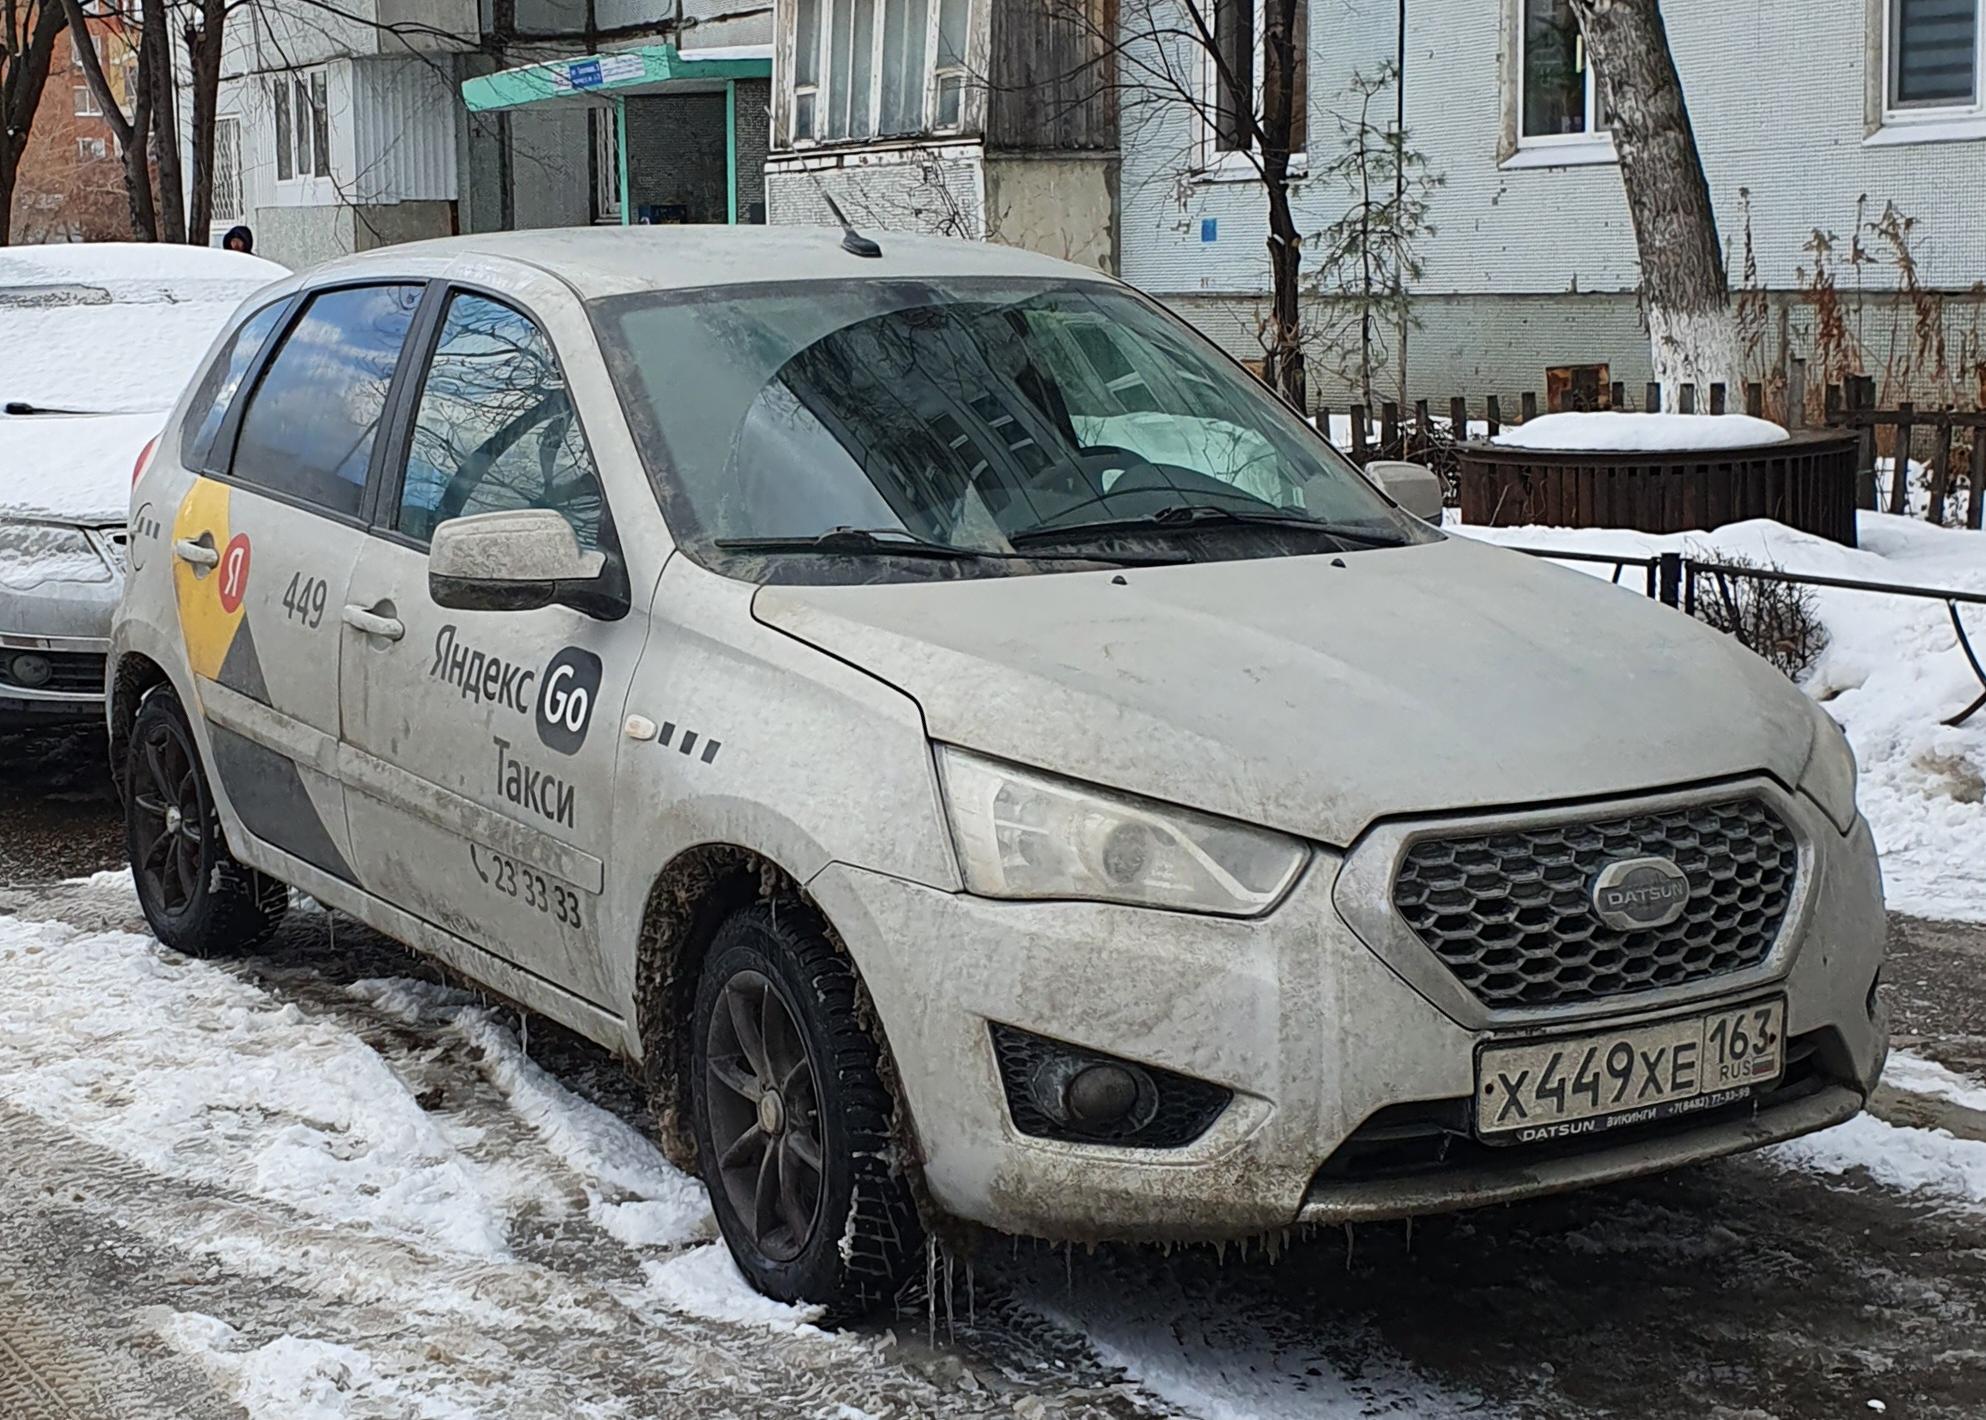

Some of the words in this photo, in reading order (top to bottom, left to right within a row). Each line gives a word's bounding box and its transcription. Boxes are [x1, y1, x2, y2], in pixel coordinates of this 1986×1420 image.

[225, 548, 245, 598] Я
[282, 571, 327, 630] 449
[429, 624, 536, 714] Яндекс
[543, 664, 588, 732] Go
[493, 736, 576, 829] Такси
[493, 855, 518, 897] 23
[523, 869, 549, 913] 33
[554, 885, 582, 929] 33
[1608, 879, 1685, 905] DATSUN
[1709, 1008, 1772, 1063] 163
[1719, 1060, 1751, 1082] RUS
[1521, 1120, 1596, 1143] DATSUN
